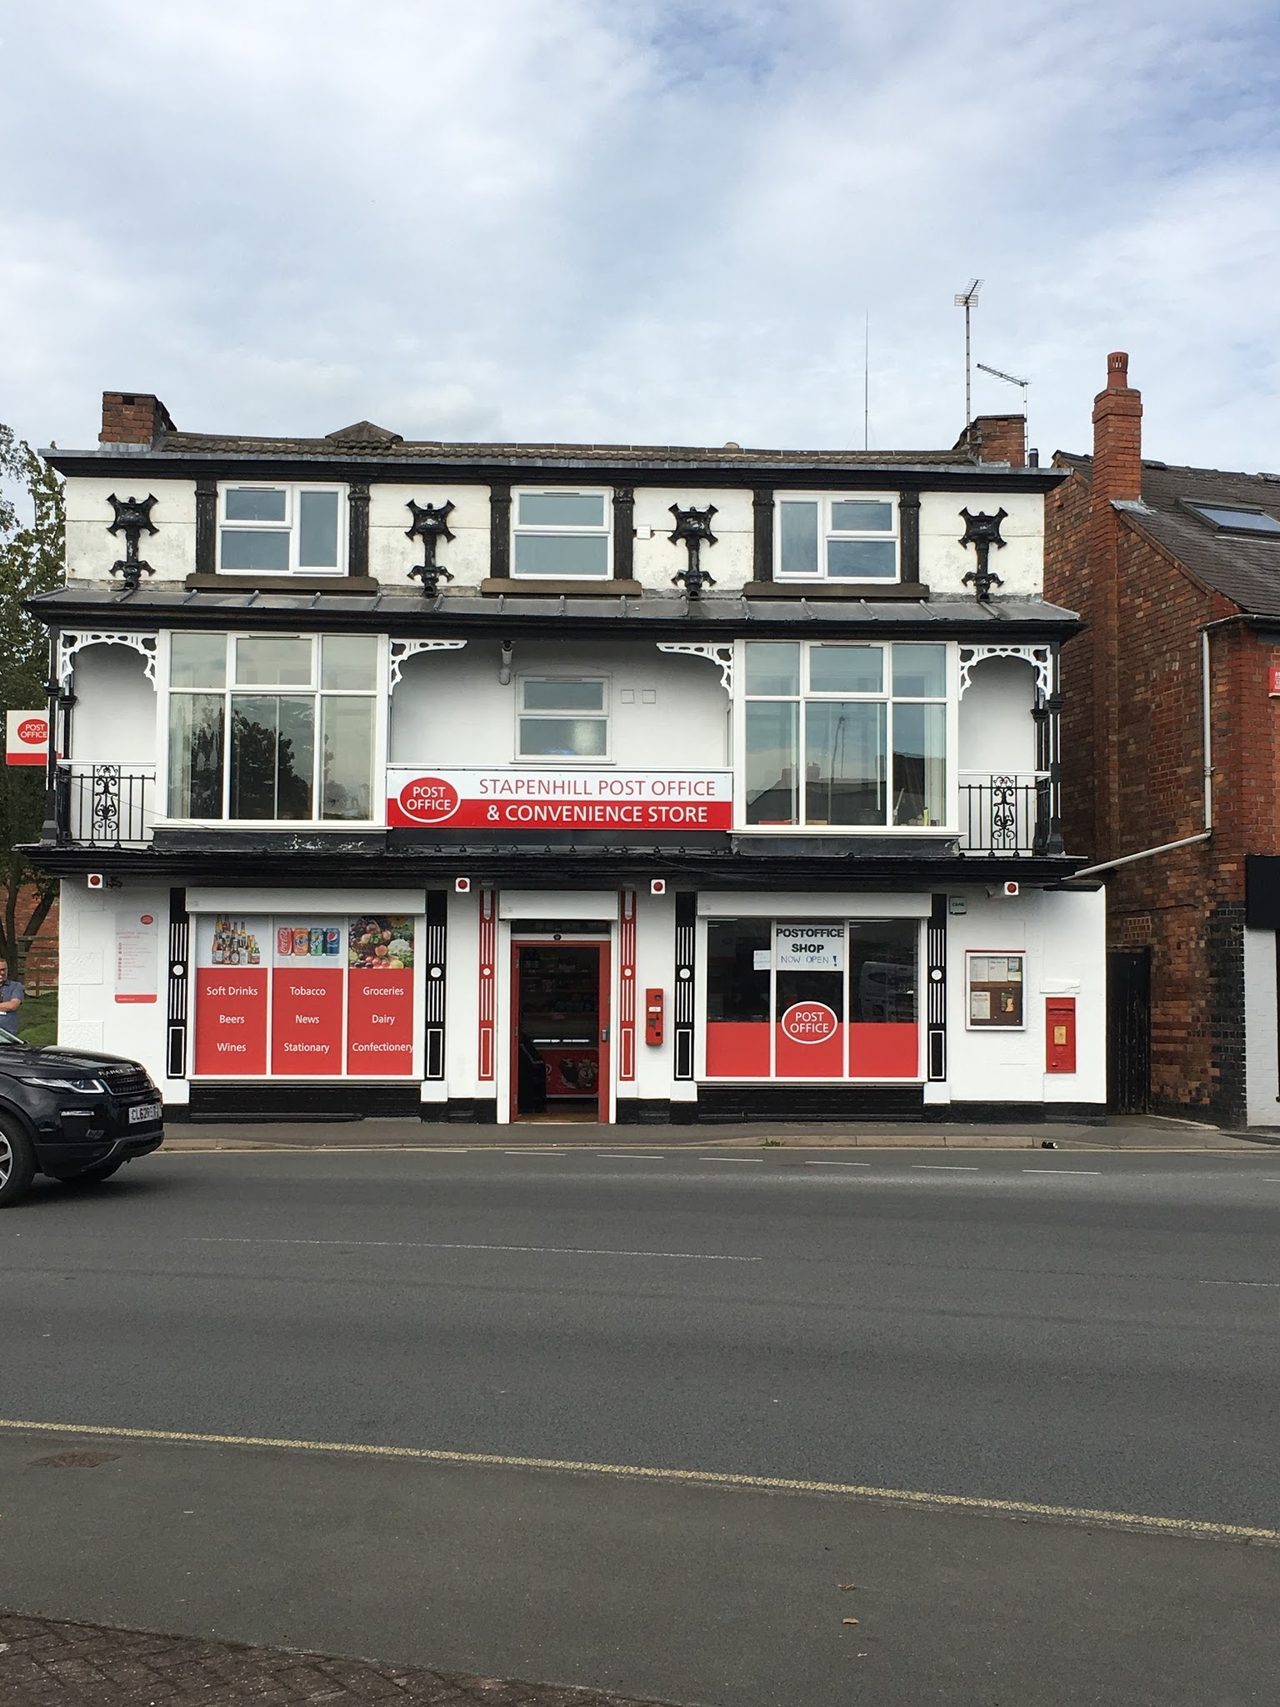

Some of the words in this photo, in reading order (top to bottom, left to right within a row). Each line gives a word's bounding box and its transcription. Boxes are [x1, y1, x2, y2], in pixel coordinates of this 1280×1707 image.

[25, 723, 46, 732] POST
[20, 731, 48, 739] OFFICE
[412, 786, 446, 798] POST
[479, 778, 593, 796] STAPENHILL
[598, 780, 646, 796] POST
[651, 780, 716, 797] OFFICE
[406, 799, 451, 811] OFFICE
[486, 804, 500, 821] &
[505, 804, 643, 822] CONVENIENCE
[648, 805, 708, 823] STORE
[791, 943, 825, 954] SHOP
[780, 955, 801, 964] NOW
[805, 955, 829, 964] OPEN
[206, 986, 226, 996] Soft
[228, 986, 258, 996] Drinks
[290, 986, 326, 996] Tobacco
[362, 986, 405, 996] Groceries
[219, 1014, 246, 1024] Beers
[295, 1014, 320, 1024] News
[371, 1014, 396, 1025] Dairy
[795, 1011, 825, 1022] POST
[790, 1023, 829, 1033] OFFICE
[216, 1042, 247, 1052] Wines
[283, 1042, 330, 1054] Stationary
[351, 1042, 413, 1053] Confectionery
